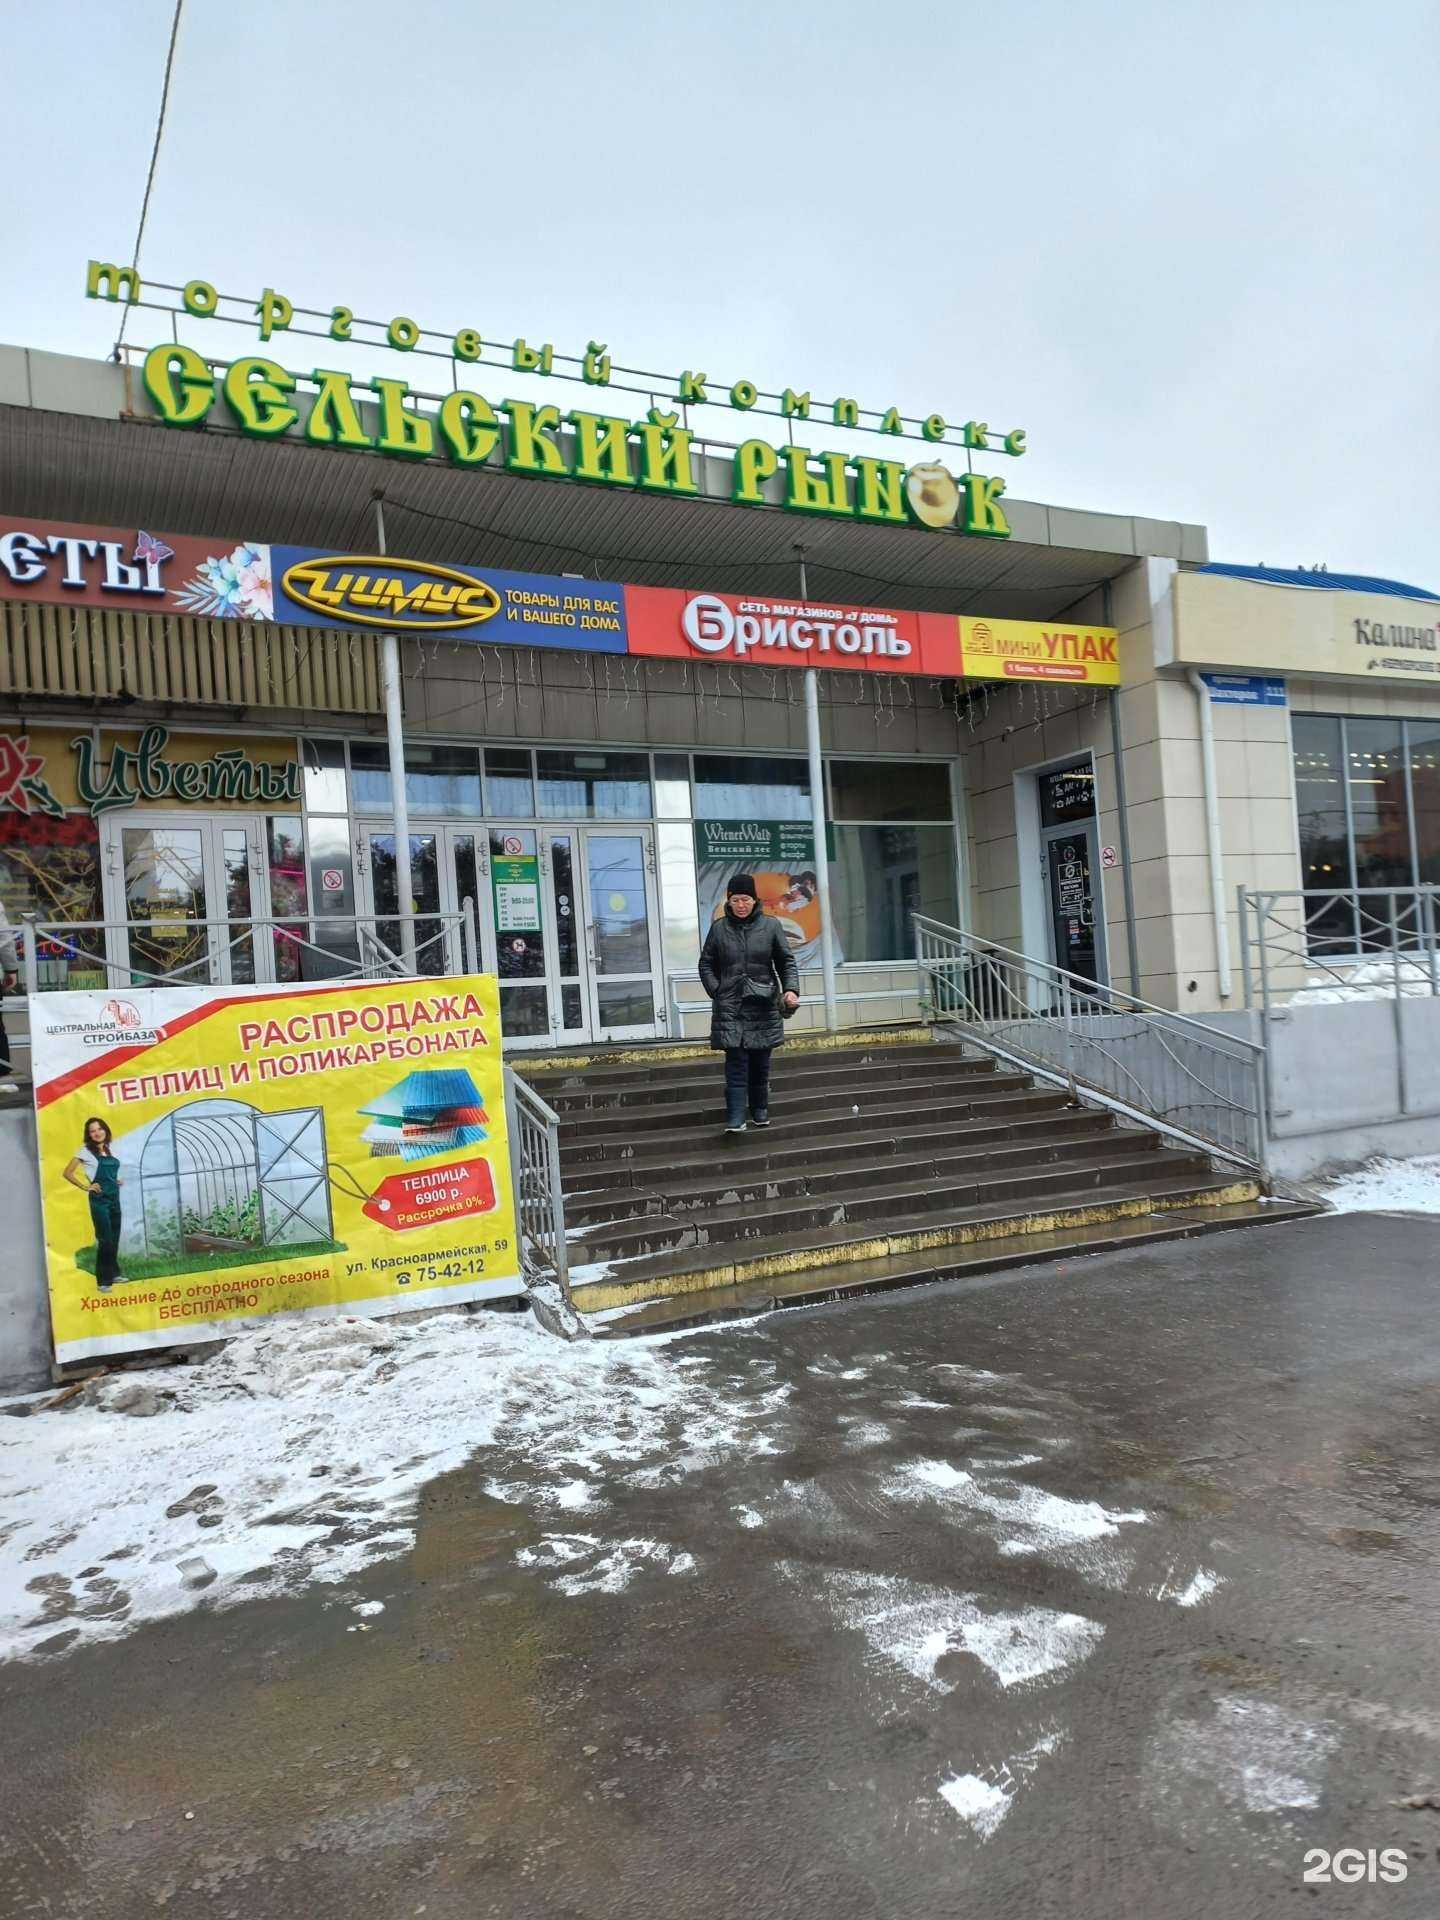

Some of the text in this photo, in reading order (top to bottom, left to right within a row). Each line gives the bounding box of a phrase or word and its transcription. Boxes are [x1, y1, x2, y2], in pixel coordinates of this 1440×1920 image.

[143, 343, 699, 497] СЕЛЬСКИЙ
[680, 370, 1026, 456] комплекс
[505, 589, 620, 614] ТОВАРЫ ДЛЯ ВАС
[739, 602, 770, 614] СЕТЬ
[772, 606, 843, 620] МАГАЗИНОВ
[507, 607, 621, 631] И ВАШЕГО ДОМА
[71, 724, 304, 817] Цветы
[46, 1022, 116, 1035] ЦЕНТРАЛЬНАЯ
[239, 993, 485, 1051] РАСПРОДАЖА
[83, 1030, 156, 1044] СТРОЙБАЗА
[99, 1027, 490, 1106] ТЕПЛИЦ И ПОЛИКАРБОНАТА
[401, 1167, 471, 1192] ТЕПЛИЦА
[415, 1188, 464, 1206] 6900 р.
[397, 1200, 465, 1225] Рассрочка
[346, 1261, 368, 1276] ул.
[494, 1239, 509, 1251] 59
[416, 1258, 485, 1283] 75-42-12
[80, 1268, 331, 1313] Хранение до огородного сезона
[159, 1293, 259, 1320] БЕСПЛАТНО
